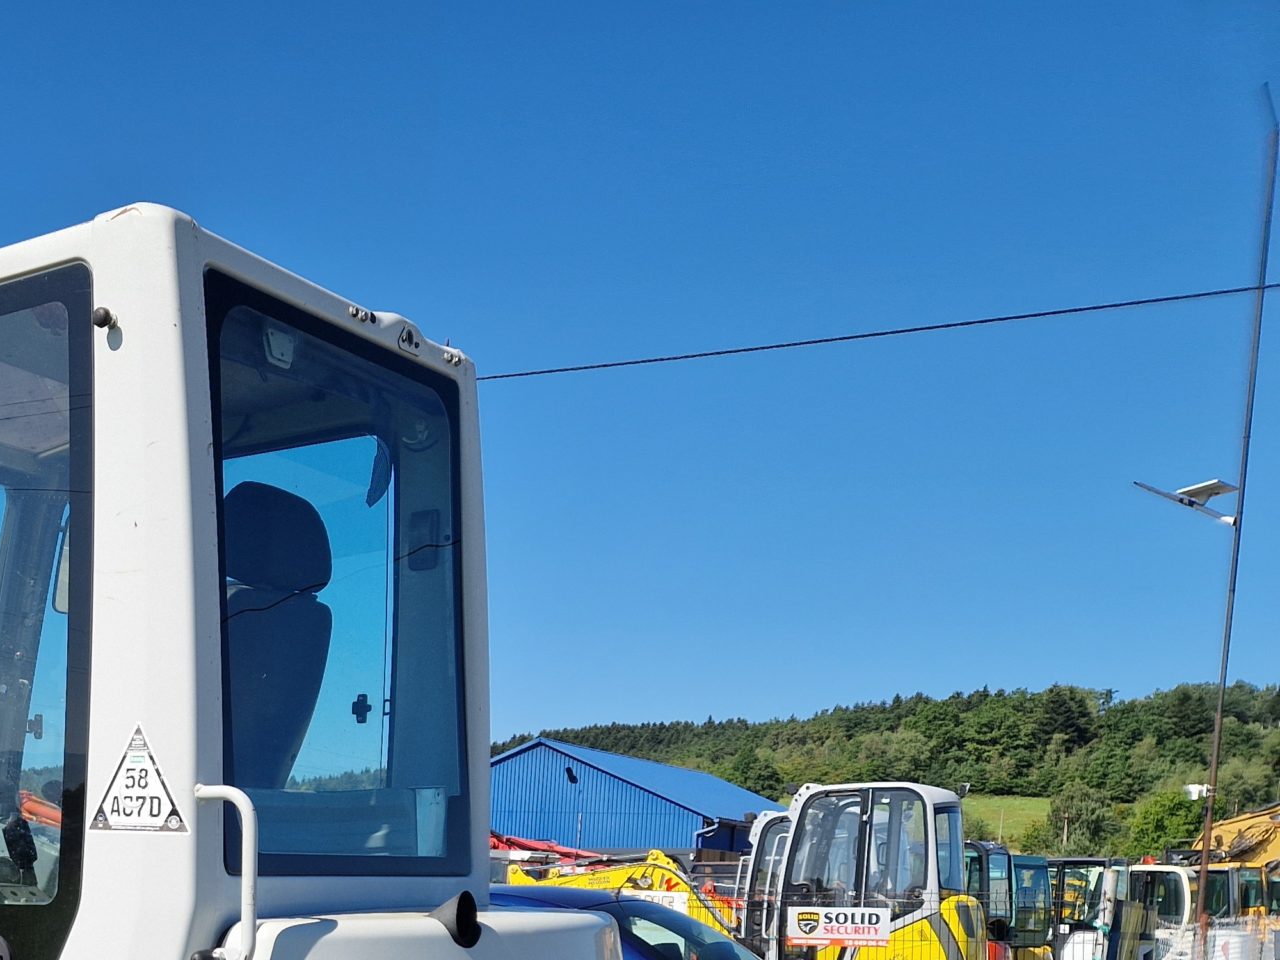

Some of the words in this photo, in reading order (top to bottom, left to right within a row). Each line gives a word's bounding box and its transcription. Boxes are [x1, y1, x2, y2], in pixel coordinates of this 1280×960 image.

[125, 768, 148, 789] 58
[823, 911, 881, 926] SOLID
[823, 925, 880, 936] SECURITY
